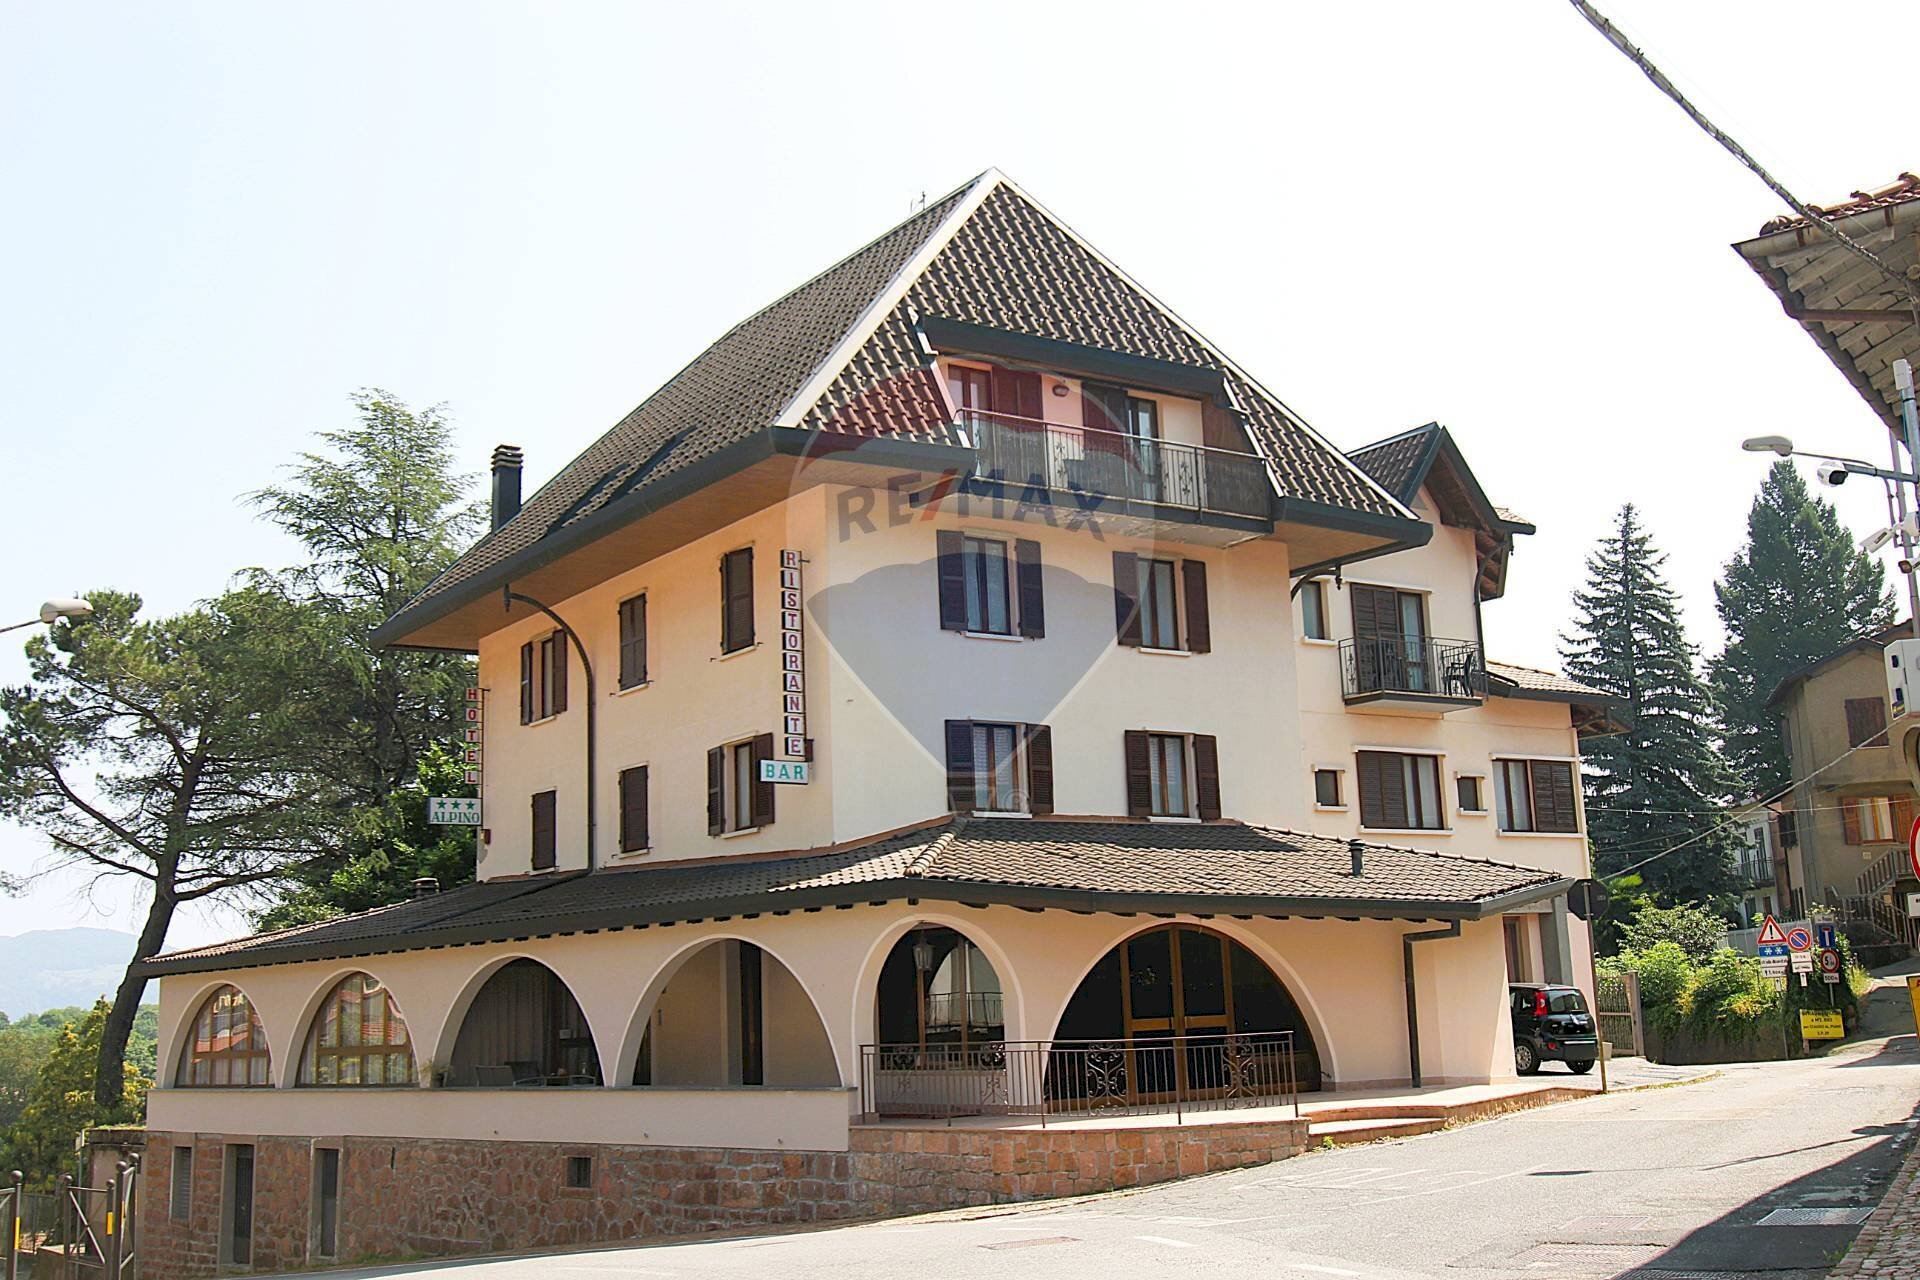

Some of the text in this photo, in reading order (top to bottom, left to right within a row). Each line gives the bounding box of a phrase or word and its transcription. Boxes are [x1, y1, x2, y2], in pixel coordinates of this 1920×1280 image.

[786, 552, 801, 753] RISTORANTE
[467, 689, 477, 782] HOTEL
[766, 763, 804, 780] BAR
[431, 811, 480, 823] ALPINO
